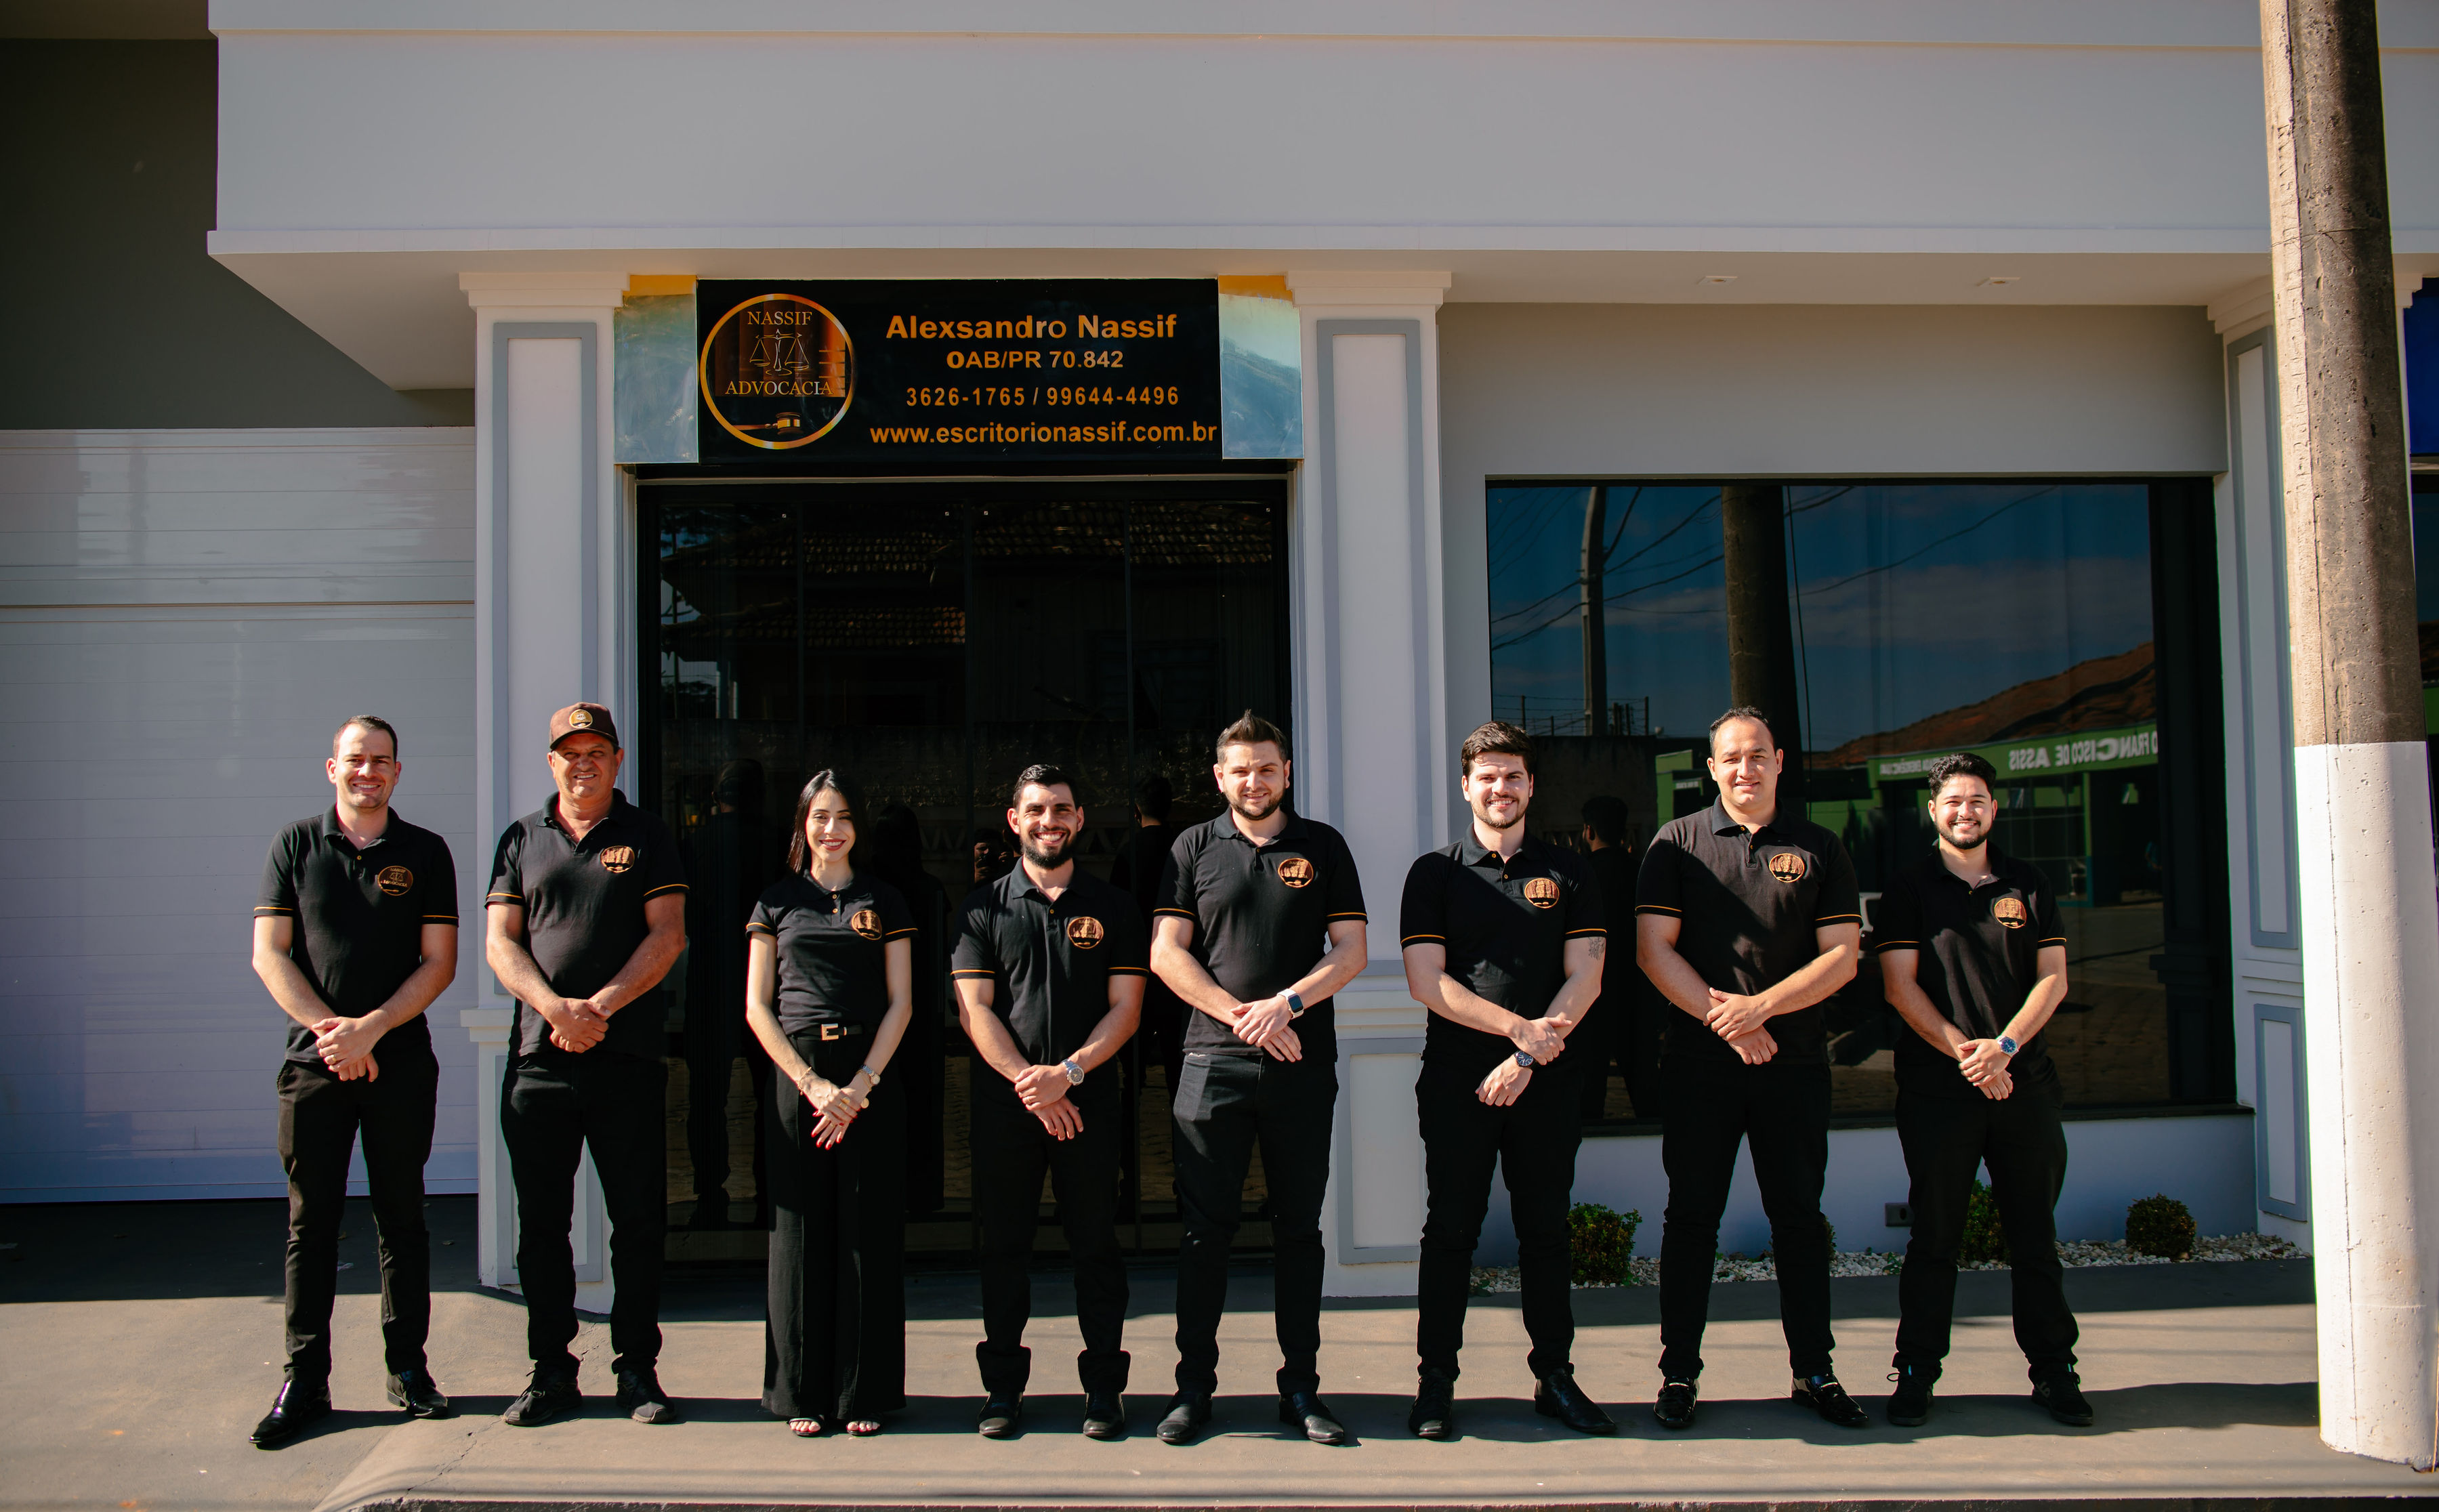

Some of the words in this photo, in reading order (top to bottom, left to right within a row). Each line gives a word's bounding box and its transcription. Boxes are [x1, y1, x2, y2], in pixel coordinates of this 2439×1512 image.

[747, 311, 813, 326] NASSIF
[885, 315, 1067, 339] Alexsandro
[1078, 314, 1177, 339] Nassif
[946, 351, 1042, 369] OAB/PR
[1049, 350, 1124, 369] 70.842
[725, 380, 833, 395] ADVOCACIA
[906, 387, 1026, 406] 3626-1765
[1032, 386, 1039, 406] /
[1046, 385, 1180, 406] 99644-4496
[869, 420, 1218, 444] www.escritorionassif.com.br
